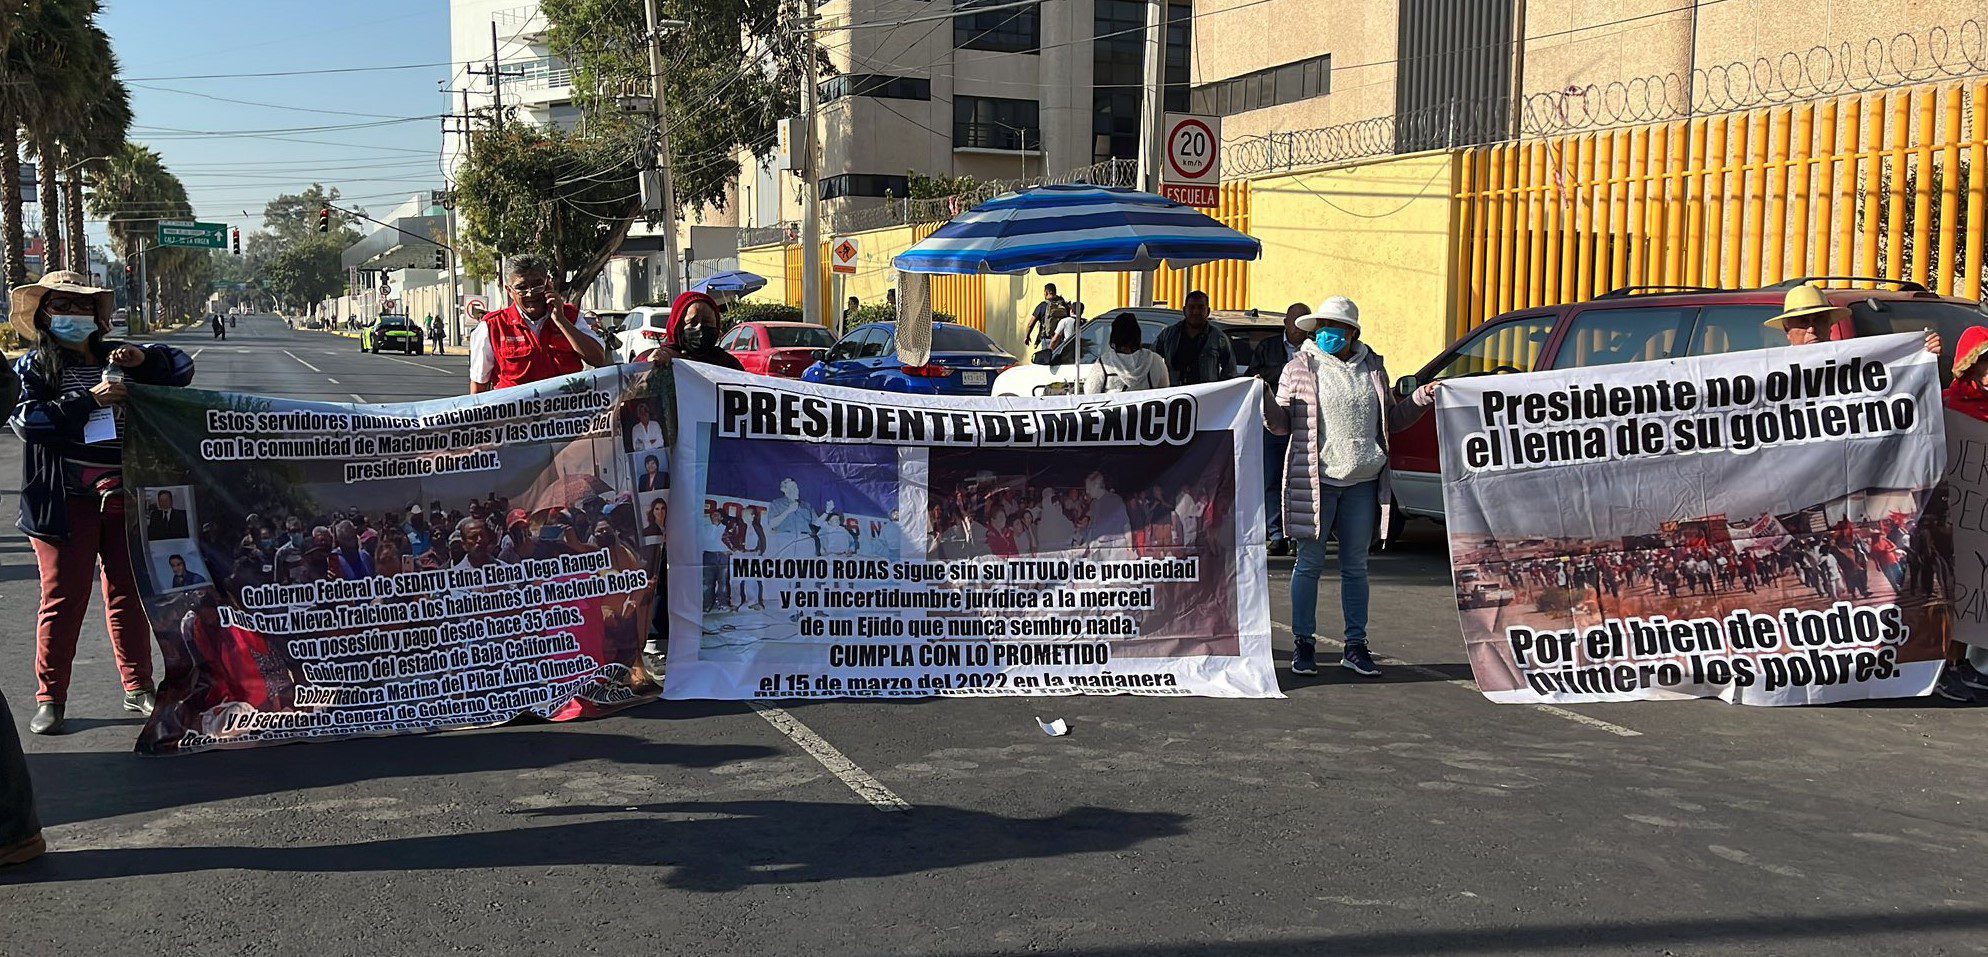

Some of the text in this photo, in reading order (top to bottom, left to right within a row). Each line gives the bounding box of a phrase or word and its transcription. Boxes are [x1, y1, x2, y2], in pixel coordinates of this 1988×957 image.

[1180, 131, 1205, 157] 20
[1167, 188, 1215, 204] ESCUELA
[209, 390, 610, 431] Estos servidores públicos traicionaron los acuerdos
[1482, 357, 1888, 426] Presidente no olvide
[203, 413, 611, 458] con la comunidad de Maclovio Rojas y las ordenes del
[722, 388, 1196, 444] PRESIDENTE DE MÉXICO
[1466, 398, 1914, 468] el lema de su gobierno
[346, 452, 499, 482] presidente Obrador.
[244, 550, 610, 606] Gobierno Federal de SEDATU Edna Elena Vega Rangel
[734, 558, 1196, 582] MACLOVIO ROJAS sigue sin su TITULO de propiedad
[220, 571, 646, 632] y Luis Cruz Nieva. Traiciona a los habitantes de Maclovio Rojas
[780, 588, 1152, 609] y en incertidumbre jurídica a la merced
[290, 606, 582, 658] con posesión y pago desde hace 35 años.
[800, 616, 1137, 638] de un Ejido que nunca sembro nada.
[1510, 604, 1909, 664] Por el bien de todos,
[304, 634, 578, 682] Gobierno del estado de Baja California.
[830, 643, 1108, 667] CUMPLA CON LO PROMETIDO
[1526, 647, 1900, 696] primero los pobres.
[296, 686, 384, 706] Gobernadora
[386, 680, 438, 701] Marina
[442, 676, 464, 696] del
[468, 670, 500, 690] Pilar
[504, 663, 538, 683] Ávila
[541, 655, 598, 678] Olmeda.
[760, 672, 1176, 691] el 15 de marzo del 2022 en la mañanera
[225, 713, 238, 730] y
[238, 711, 254, 728] el
[252, 712, 330, 730] secretario
[334, 708, 394, 724] General
[399, 702, 416, 719] de
[420, 697, 486, 716] Gobierno
[488, 690, 548, 709] Catalino
